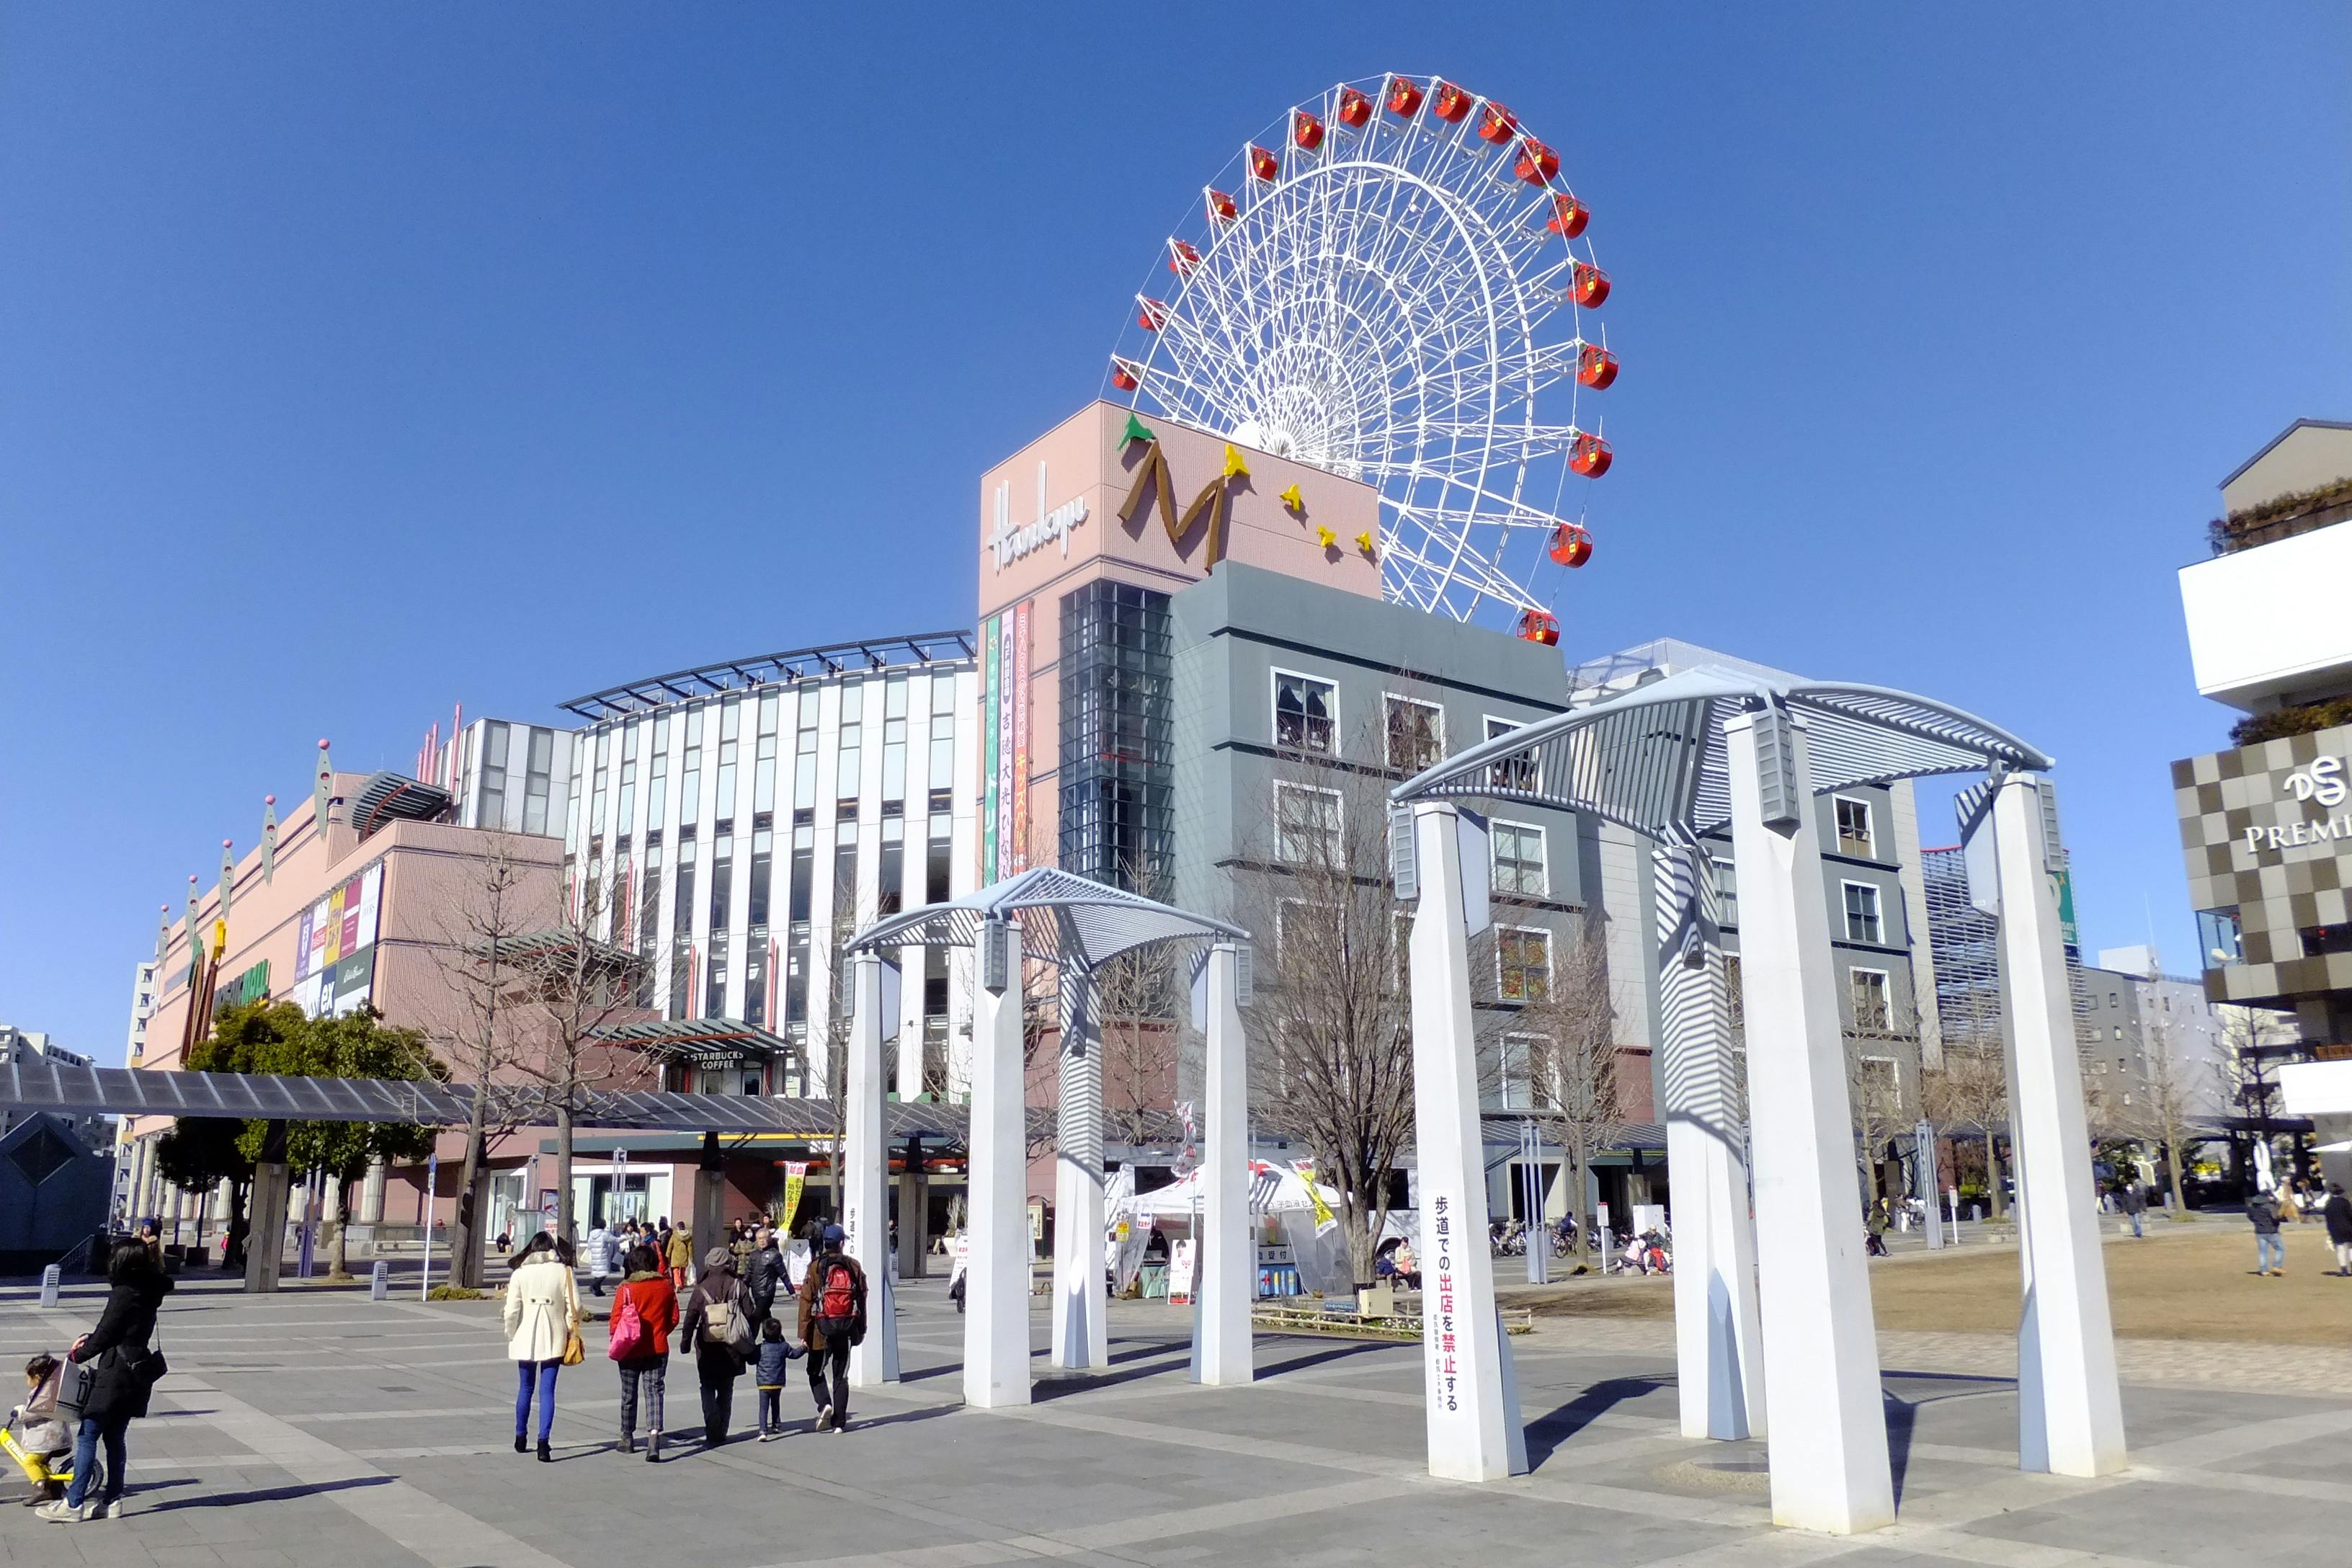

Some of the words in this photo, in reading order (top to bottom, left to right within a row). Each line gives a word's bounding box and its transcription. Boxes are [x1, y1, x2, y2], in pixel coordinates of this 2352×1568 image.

[986, 460, 1090, 573] Hankyu
[692, 1051, 744, 1061] STARBUCKS
[701, 1060, 734, 1069] COFFEE
[1435, 1195, 1458, 1412] 歩道での出店を禁止する
